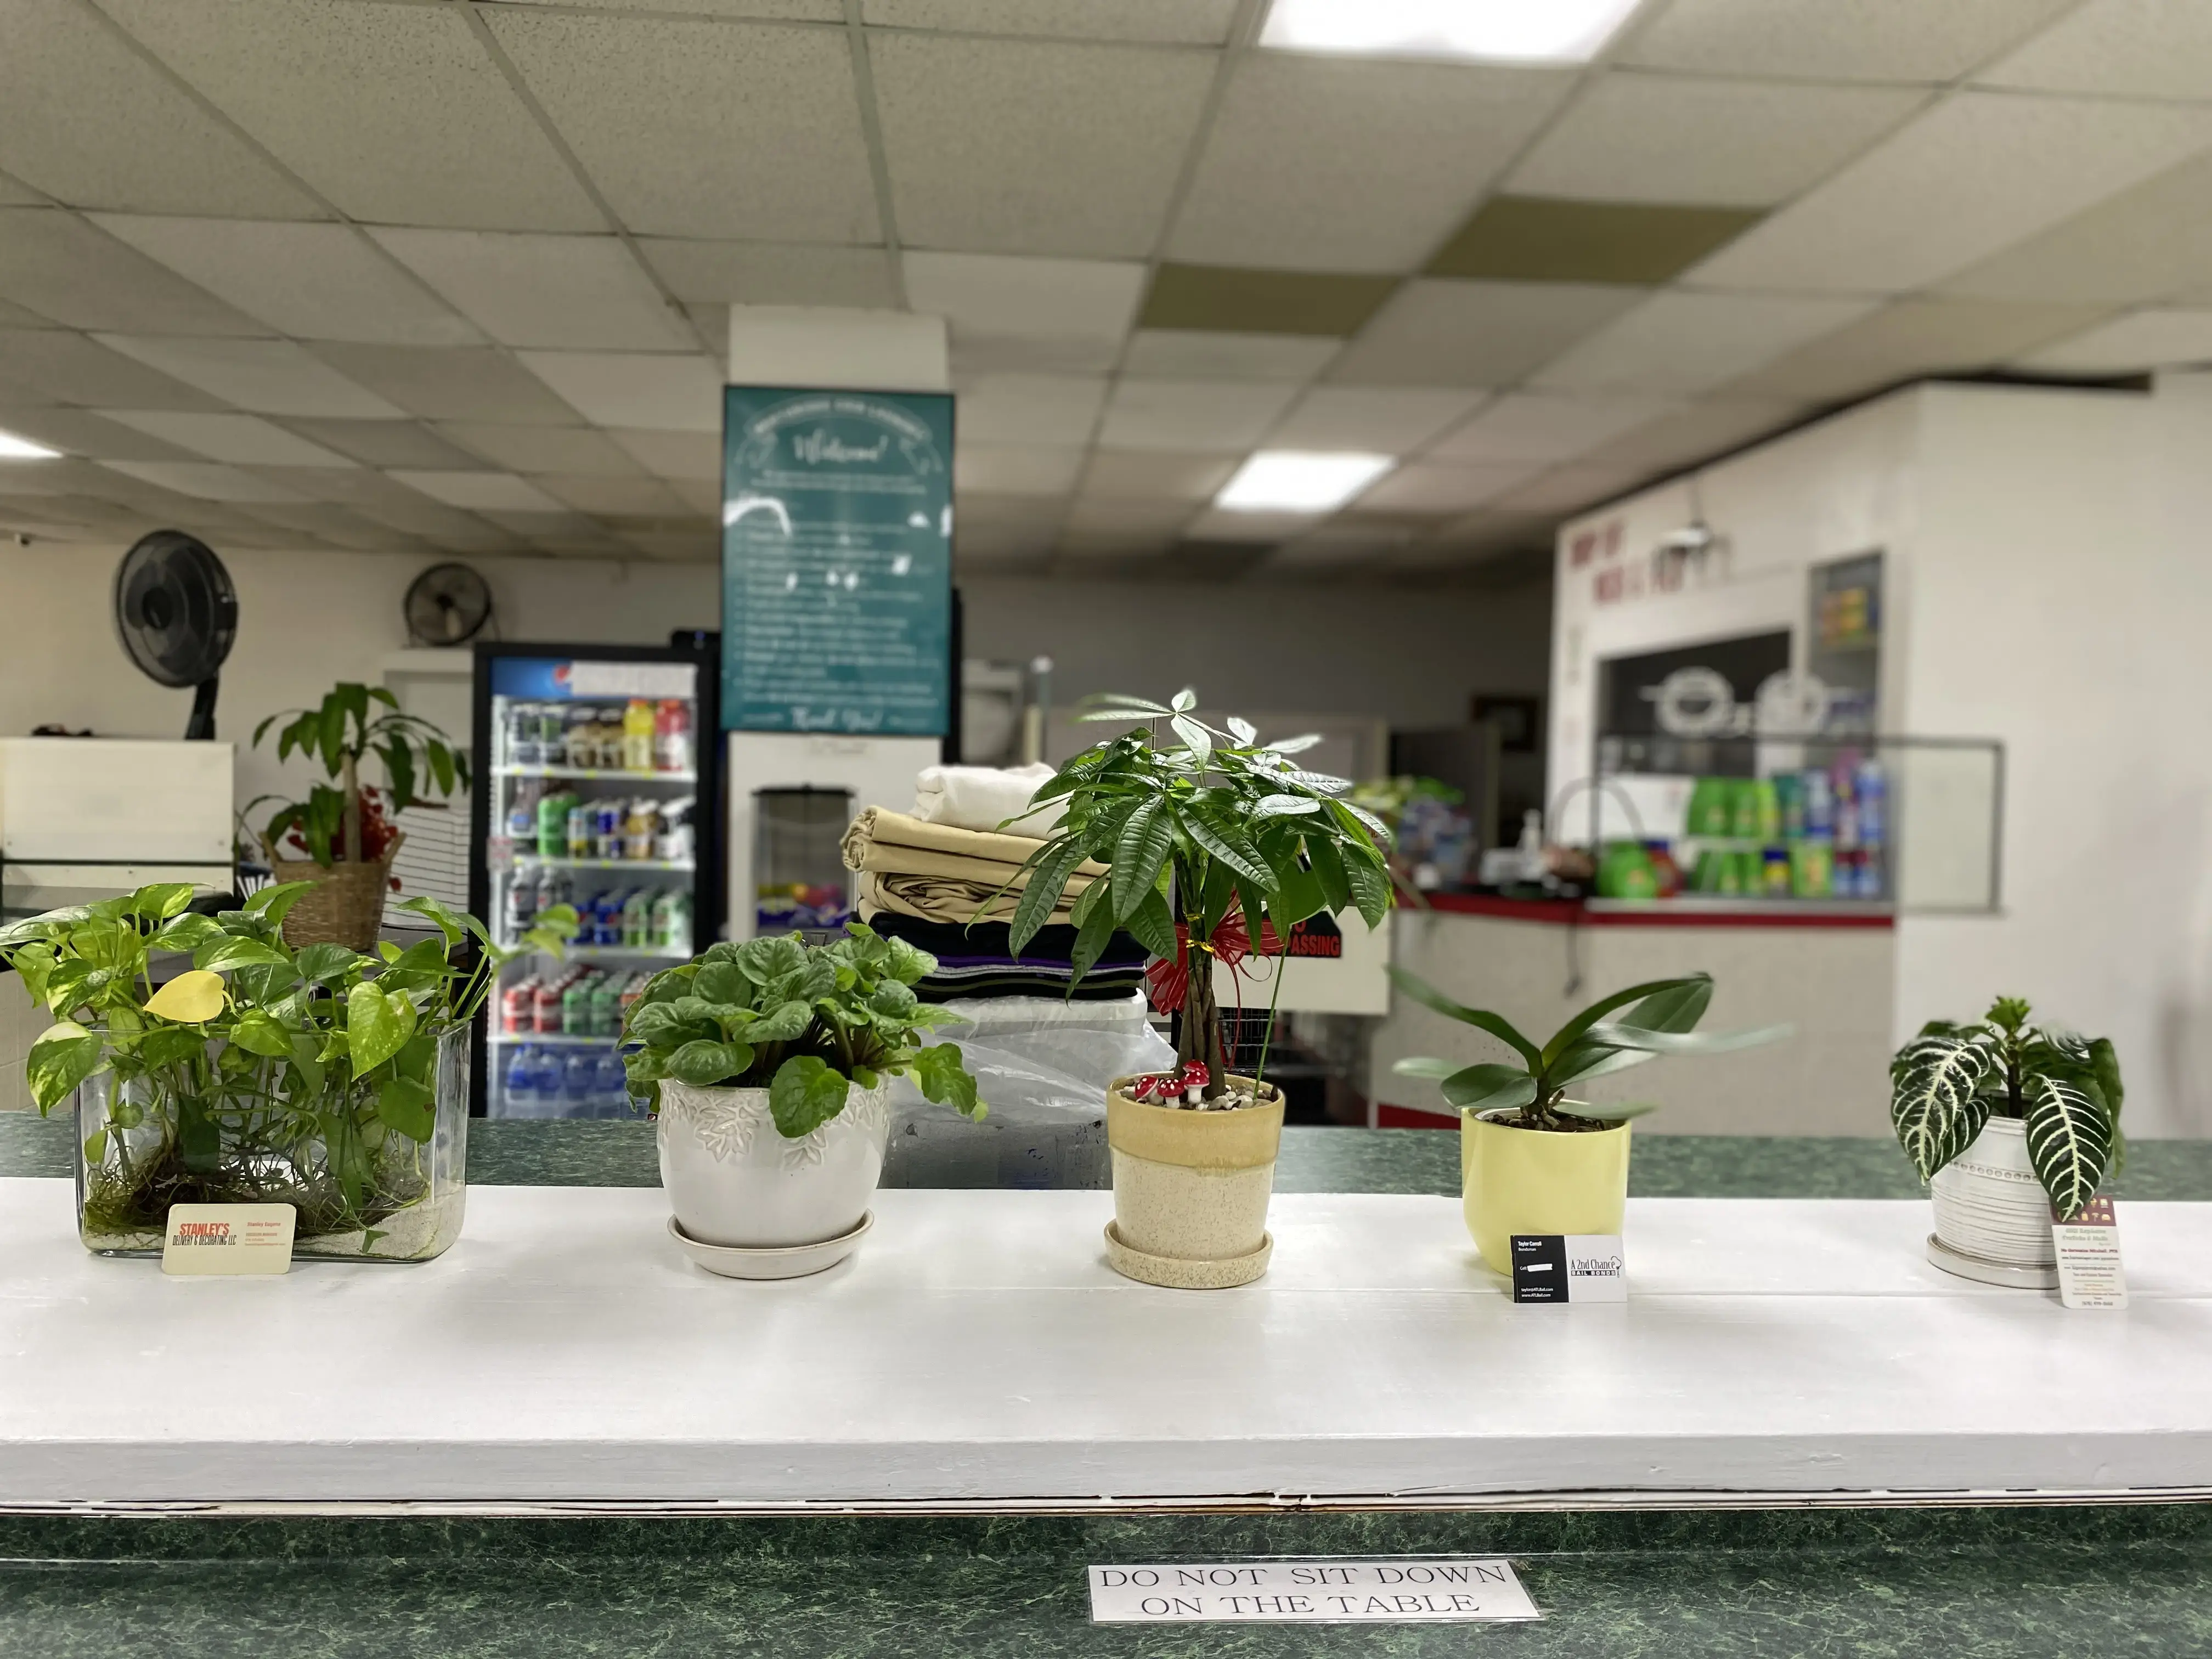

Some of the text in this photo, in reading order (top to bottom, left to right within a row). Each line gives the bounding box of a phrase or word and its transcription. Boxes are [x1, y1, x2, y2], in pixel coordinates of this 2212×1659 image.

[179, 1223, 230, 1235] STANLEY'S
[172, 1235, 193, 1246] DELIVERY
[194, 1235, 198, 1245] &
[199, 1235, 228, 1245] DECORATING
[228, 1234, 237, 1245] LLC
[1571, 1259, 1615, 1269] A 2nd Chance
[1099, 1565, 1506, 1587] DO NOT SIT DOWN
[1141, 1594, 1480, 1616] ON THE TABLE
